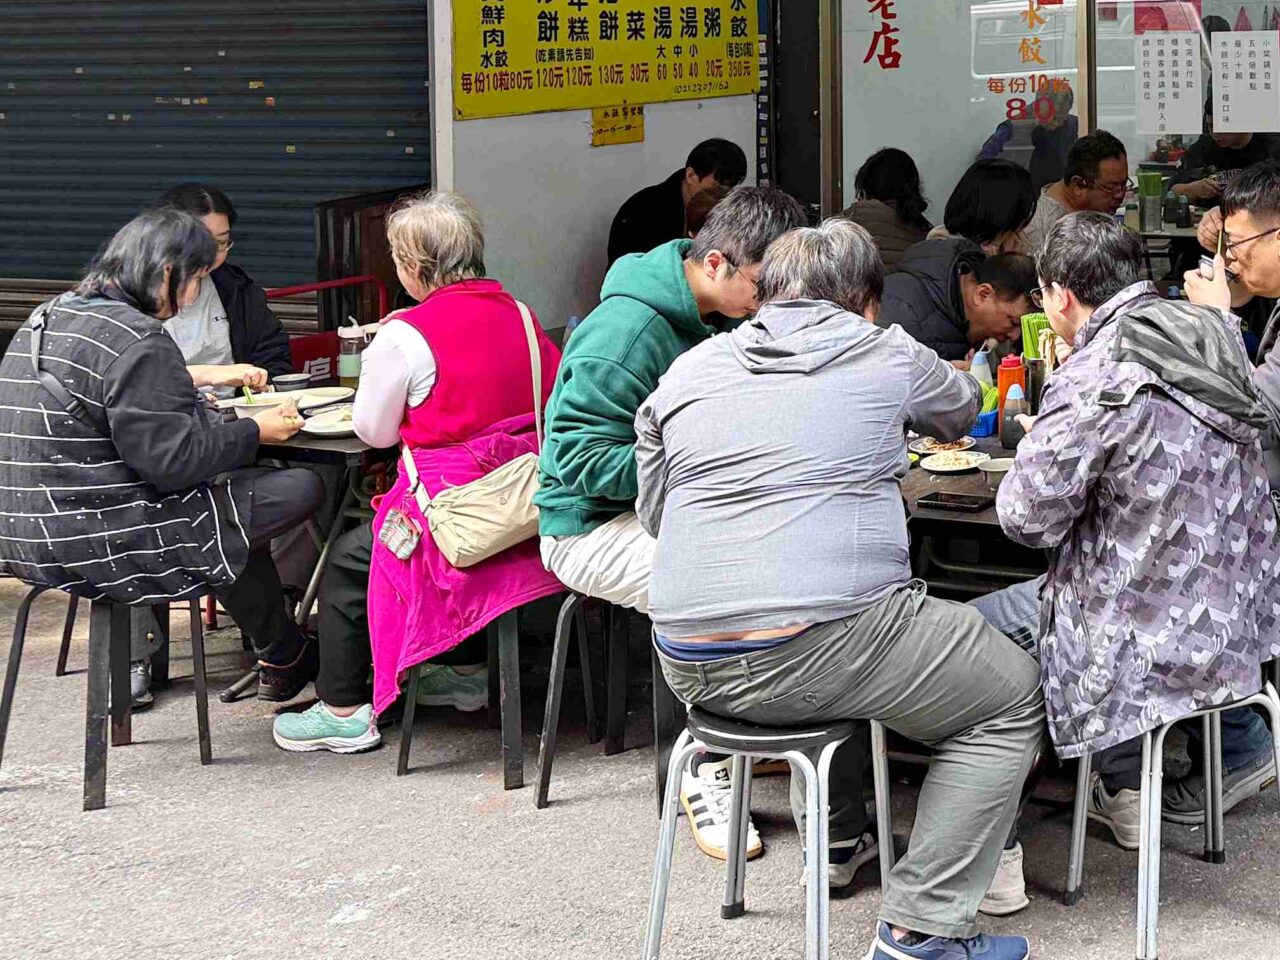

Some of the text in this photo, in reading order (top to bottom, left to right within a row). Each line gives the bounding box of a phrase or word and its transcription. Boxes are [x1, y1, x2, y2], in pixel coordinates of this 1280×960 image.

[1018, 0, 1047, 65] 水餃
[673, 45, 683, 58] 中
[689, 44, 699, 58] 小
[461, 59, 751, 94] 每份10粒80元 120元 120元 130元 30元 60 50 40 20元 350元
[1006, 96, 1056, 121] 80
